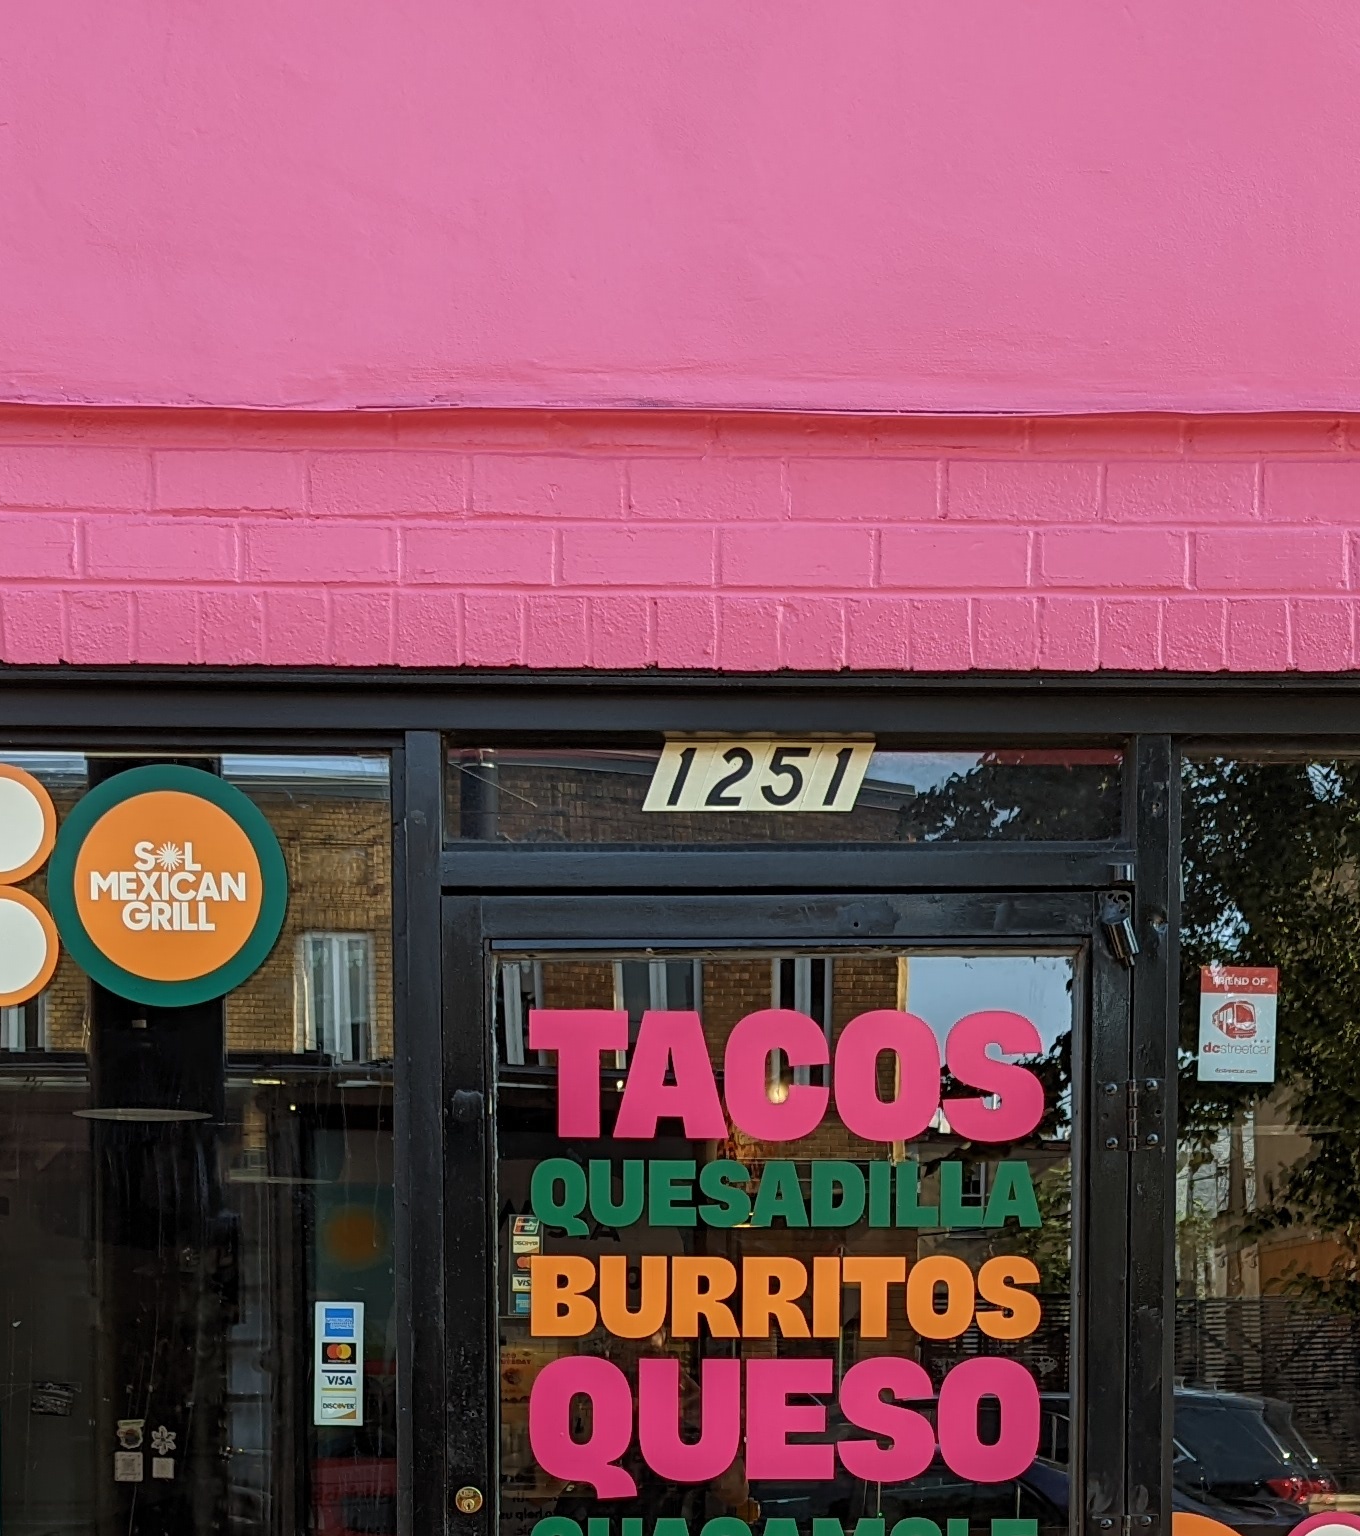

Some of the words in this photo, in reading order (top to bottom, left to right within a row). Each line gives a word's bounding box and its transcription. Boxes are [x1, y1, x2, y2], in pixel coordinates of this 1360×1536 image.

[666, 747, 857, 806] 1251
[134, 841, 201, 871] SOL
[90, 871, 246, 901] MEXICAN
[122, 901, 216, 931] GRILL
[1252, 977, 1267, 986] OF
[1203, 1042, 1271, 1055] dcstreetcar
[529, 1009, 1045, 1142] TACOS
[530, 1158, 1042, 1236] QUESADILLA
[516, 1279, 531, 1287] VIS
[530, 1255, 1042, 1340] BURRITOS
[326, 1376, 353, 1385] VISA
[529, 1355, 1042, 1499] QUESO
